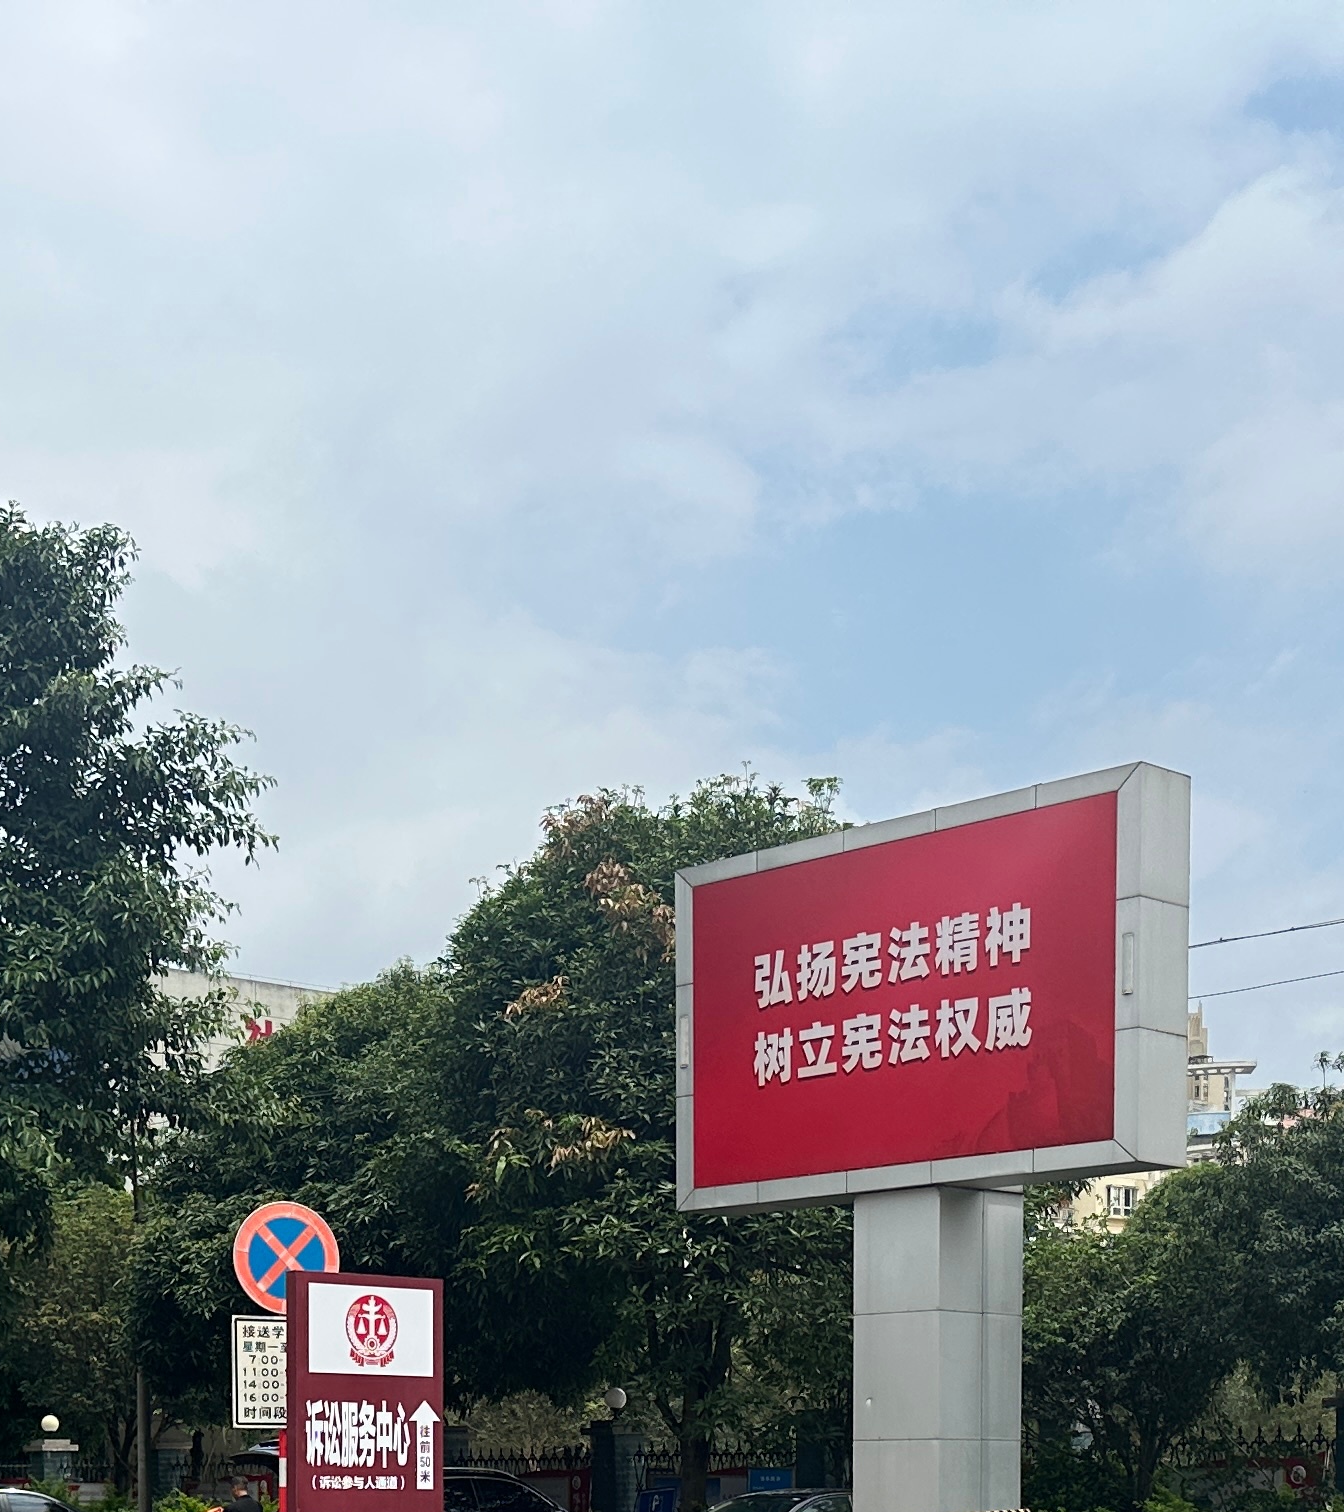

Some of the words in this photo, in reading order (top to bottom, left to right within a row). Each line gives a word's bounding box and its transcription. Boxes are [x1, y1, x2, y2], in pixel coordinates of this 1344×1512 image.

[754, 901, 1032, 1009] 弘扬宪法精神
[754, 987, 1033, 1087] 树立宪法权威
[242, 1325, 284, 1338] 接送学
[243, 1406, 287, 1419] 时间段
[305, 1399, 411, 1469] 诉讼服务中心
